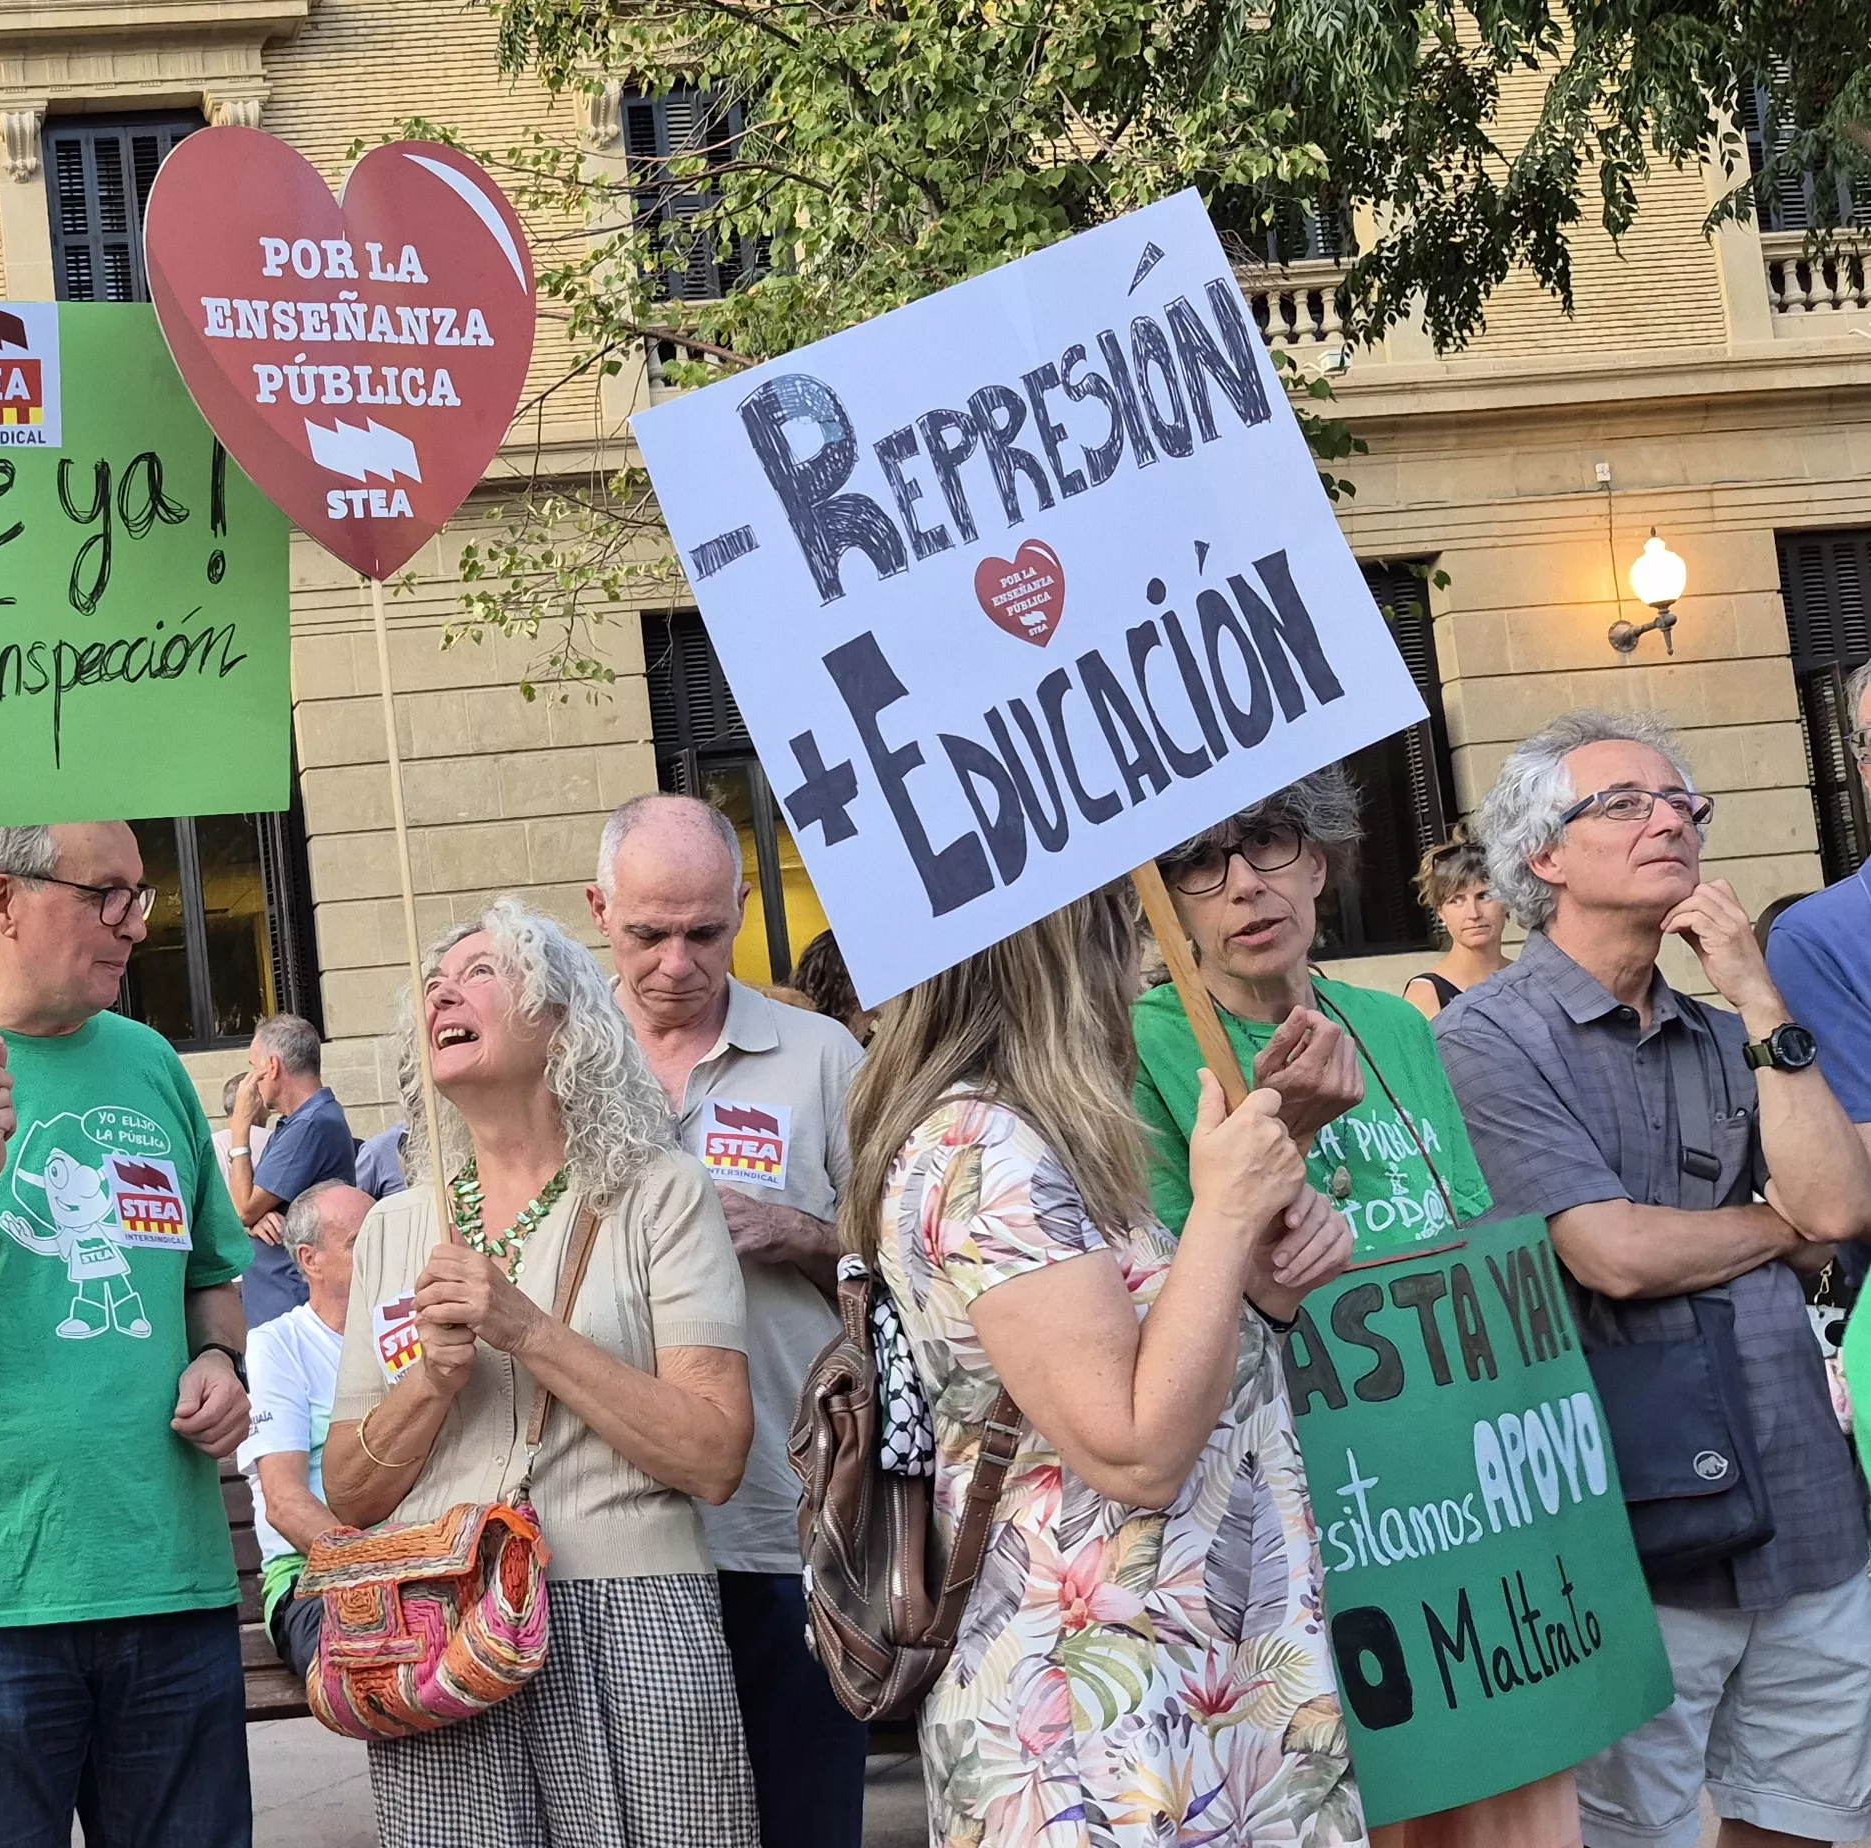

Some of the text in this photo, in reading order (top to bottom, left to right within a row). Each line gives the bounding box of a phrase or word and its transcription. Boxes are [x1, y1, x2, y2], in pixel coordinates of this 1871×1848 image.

[259, 236, 428, 284] POR LA
[201, 290, 494, 347] ENSEÑANZA
[252, 353, 461, 407] PÚBLICA
[326, 489, 414, 520] STEA
[999, 566, 1037, 588] POR LA
[991, 575, 1054, 607] ENSEÑANZA
[1006, 591, 1052, 616] PÚBLICA
[1029, 623, 1048, 637] STEA
[98, 1111, 155, 1132] YO ELIJO
[96, 1128, 166, 1150] LA PÚBLICA
[709, 1138, 779, 1162] STEA
[121, 1199, 180, 1221] STEA
[125, 1233, 187, 1245] INTERSINDICAL
[81, 1250, 114, 1264] STEA
[1485, 1240, 1572, 1368] YA!
[1474, 1393, 1608, 1533] APOYO
[1332, 1555, 1602, 1730] O Maltrato
